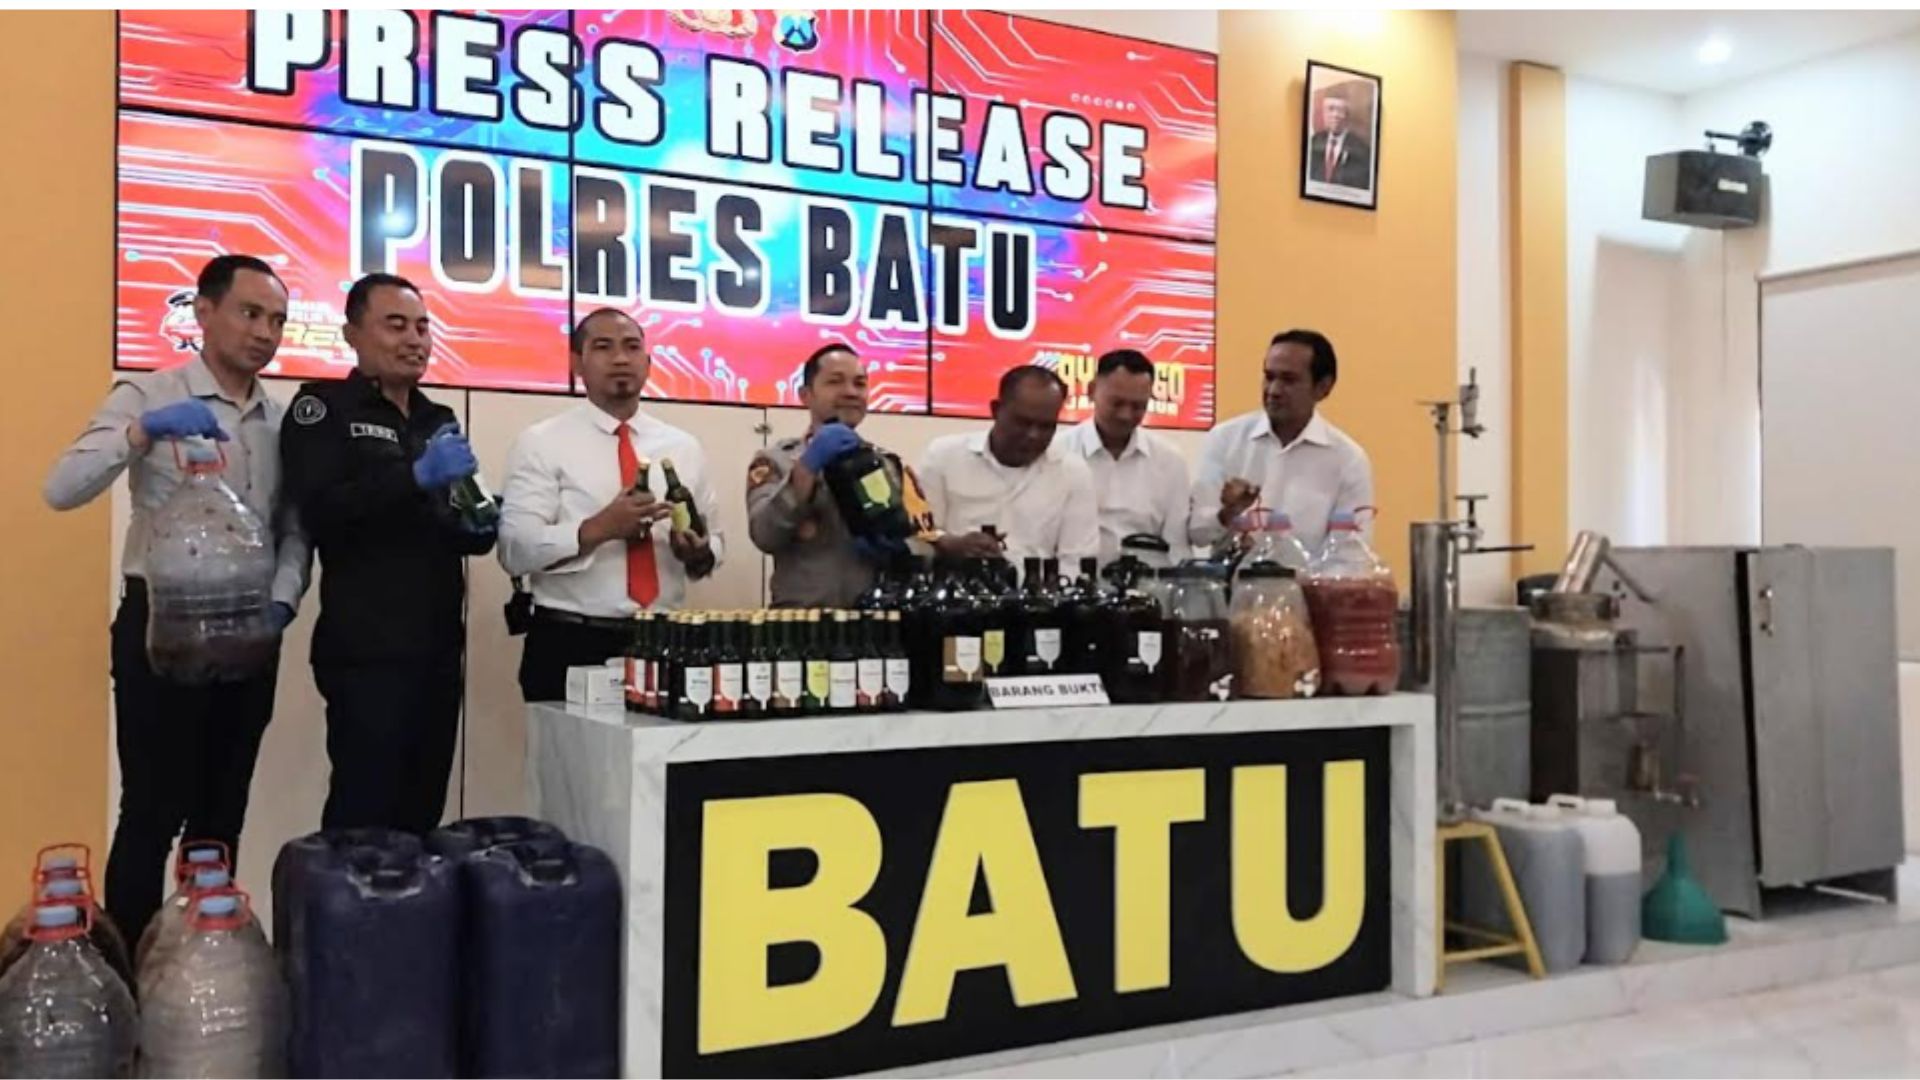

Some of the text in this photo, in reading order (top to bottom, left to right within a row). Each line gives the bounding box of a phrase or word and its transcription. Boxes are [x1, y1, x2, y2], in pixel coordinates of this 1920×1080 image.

[248, 9, 1149, 209] PRESS RELEASE
[351, 139, 1038, 339] POLRES BATU
[988, 684, 1055, 698] BARANG
[698, 759, 1366, 1054] BATU
